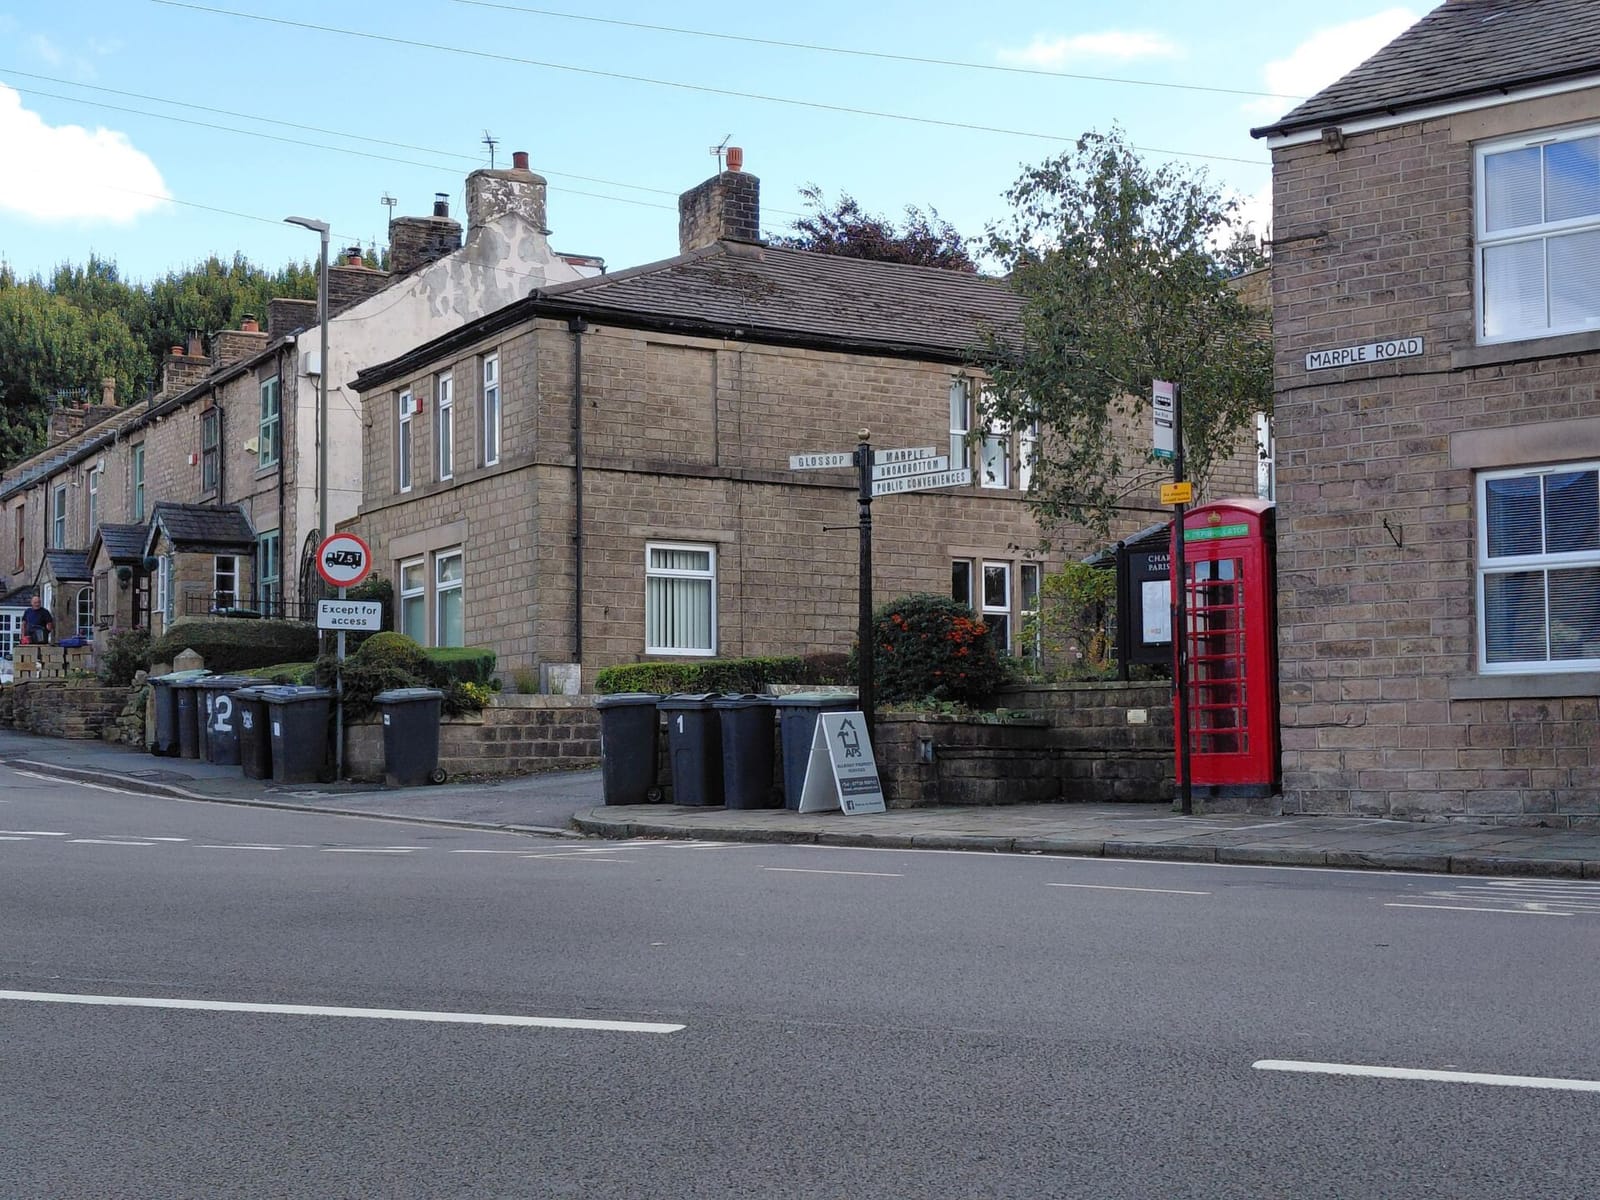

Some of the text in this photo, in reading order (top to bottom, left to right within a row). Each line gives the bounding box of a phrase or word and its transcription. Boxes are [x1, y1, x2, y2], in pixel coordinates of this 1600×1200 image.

[1310, 340, 1418, 368] MARPLE ROAD
[798, 456, 844, 467] GLOSSOP
[886, 449, 924, 462] MARPLE
[881, 460, 938, 476] BROADBOTTOM
[876, 472, 965, 492] PUBLIC CONVENIENCES
[338, 552, 352, 562] 7.5
[322, 605, 376, 614] Except for
[676, 714, 684, 734] 1
[846, 748, 862, 758] APS
